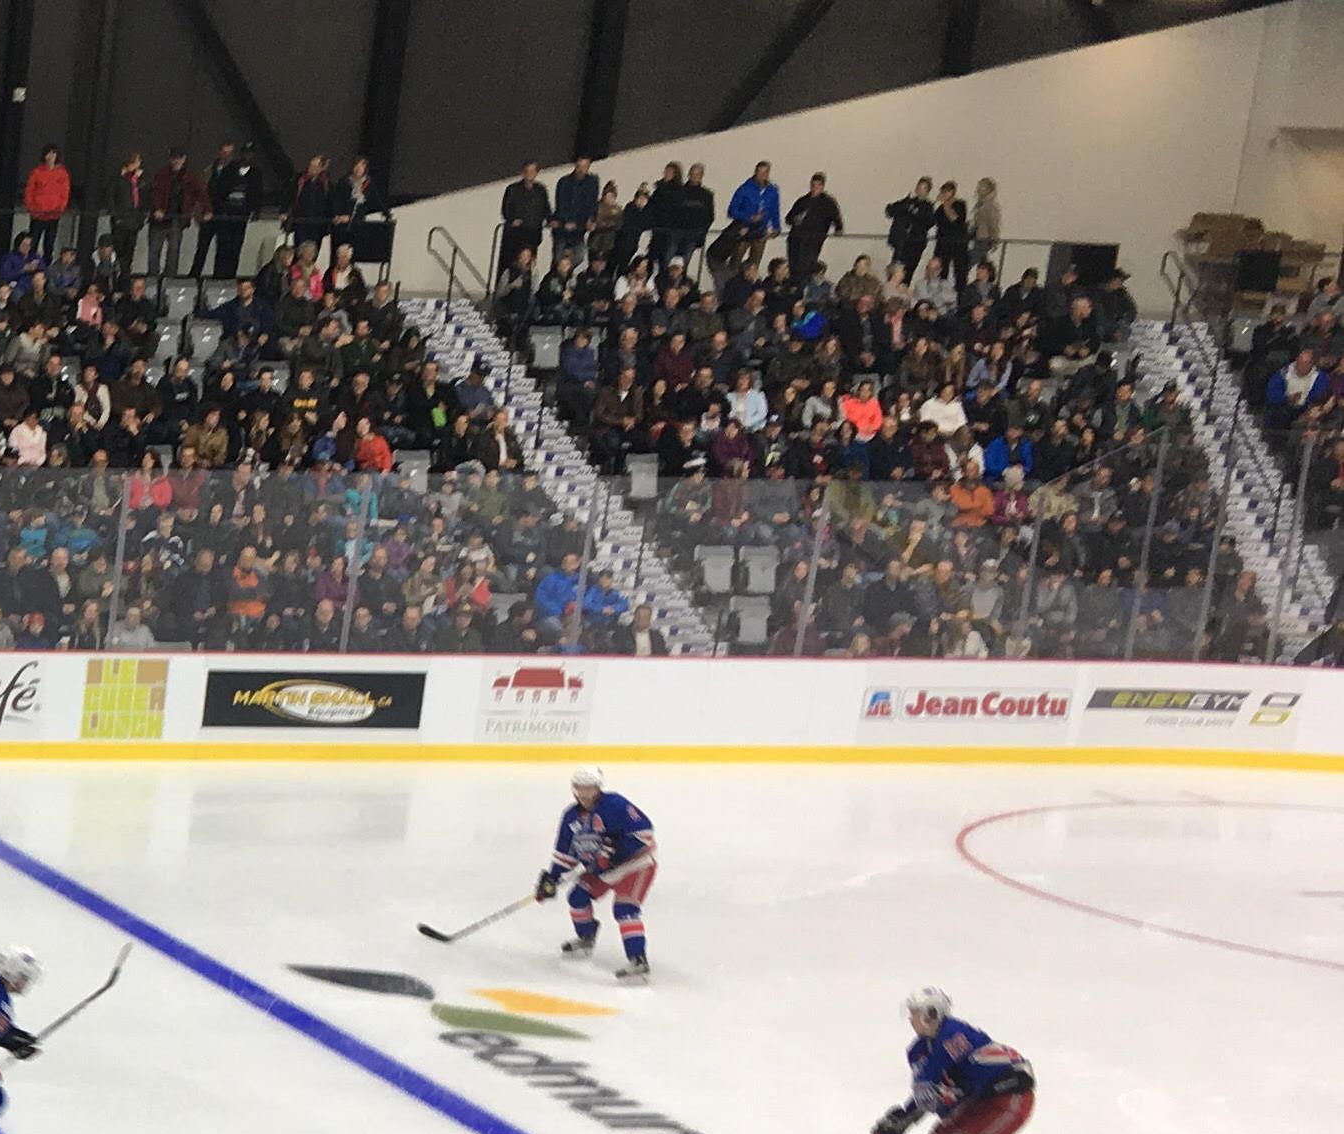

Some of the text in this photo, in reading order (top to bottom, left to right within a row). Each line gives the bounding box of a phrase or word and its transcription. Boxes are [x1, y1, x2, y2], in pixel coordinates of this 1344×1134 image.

[905, 691, 1068, 717] Jean Coutu
[1112, 690, 1245, 711] ENERGYM
